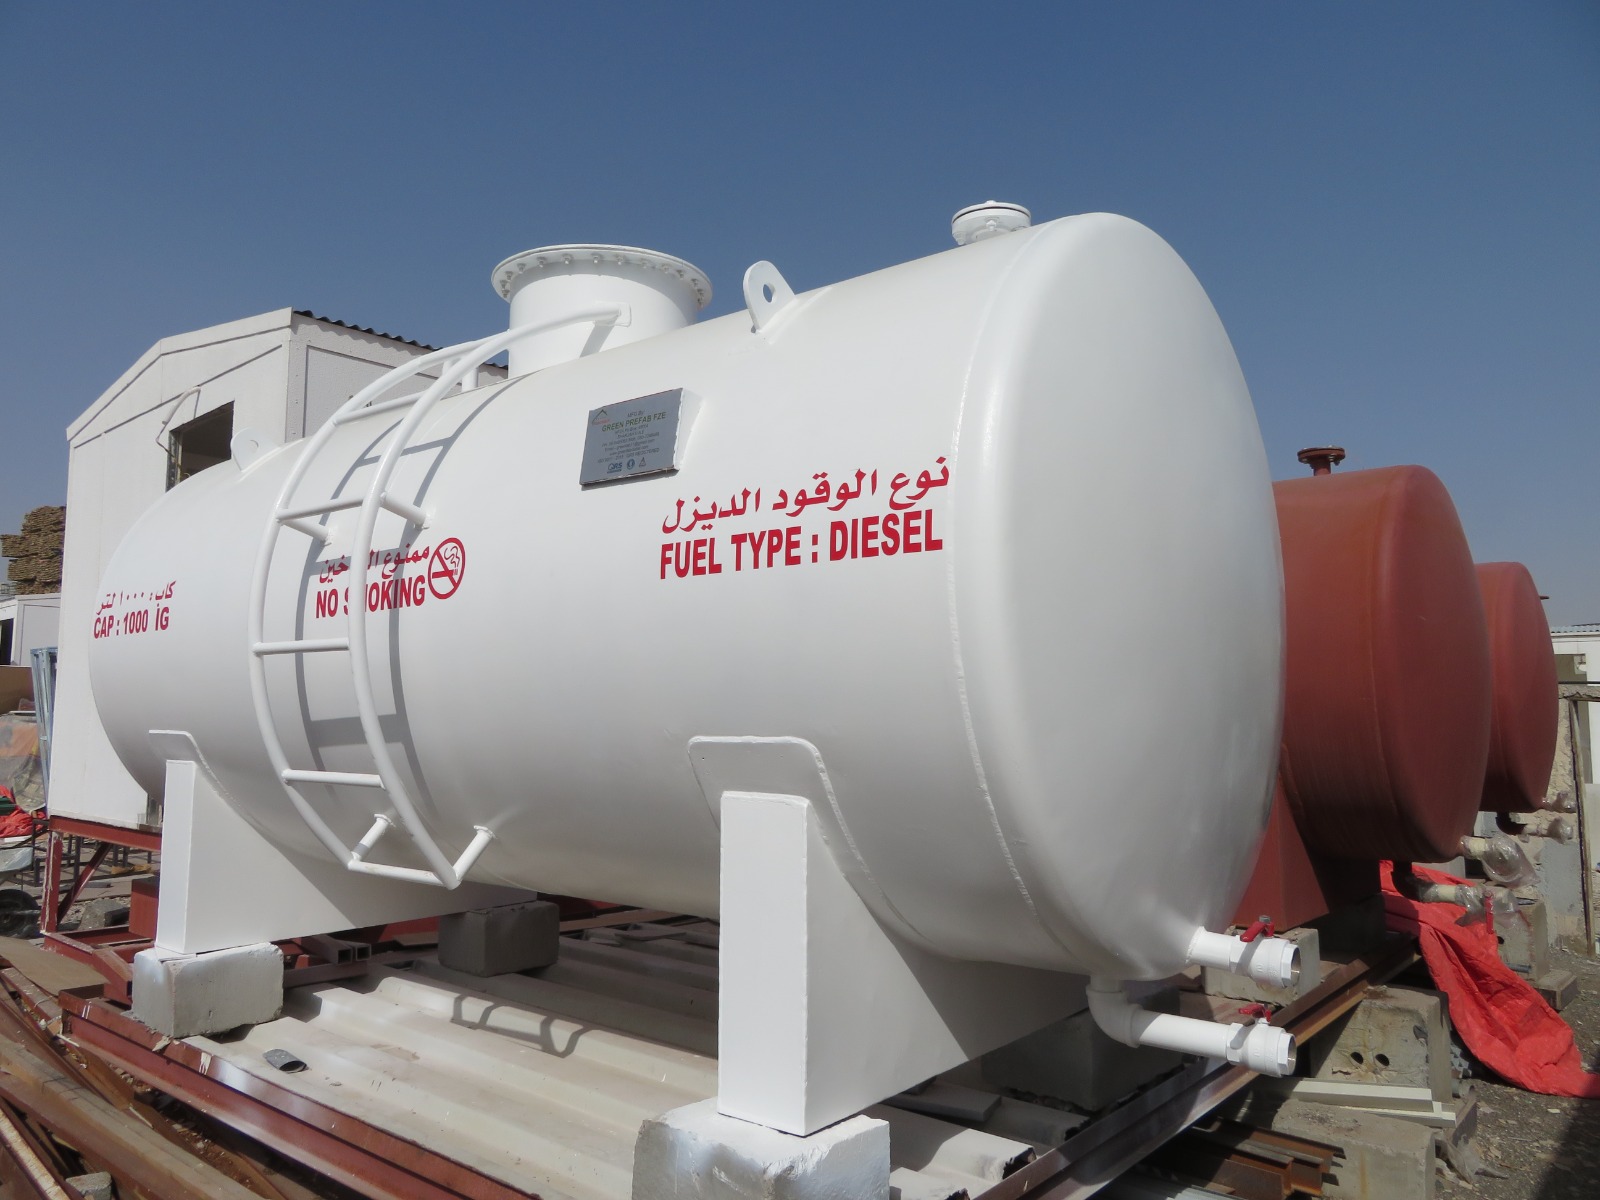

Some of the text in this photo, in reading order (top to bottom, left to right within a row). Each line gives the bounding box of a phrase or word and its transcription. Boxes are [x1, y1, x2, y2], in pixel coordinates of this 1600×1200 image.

[601, 421, 624, 432] GREEN
[625, 415, 652, 426] PREFAB
[653, 411, 667, 421] FZE
[662, 456, 950, 534] نوع الوقود الديزل
[381, 543, 430, 580] ممنوع
[660, 537, 722, 580] FUEL
[731, 526, 802, 571] TYPE
[830, 508, 943, 561] DIESEL
[315, 588, 339, 619] NO
[93, 615, 115, 639] CAP
[123, 609, 149, 635] 1000
[155, 606, 170, 631] IG
